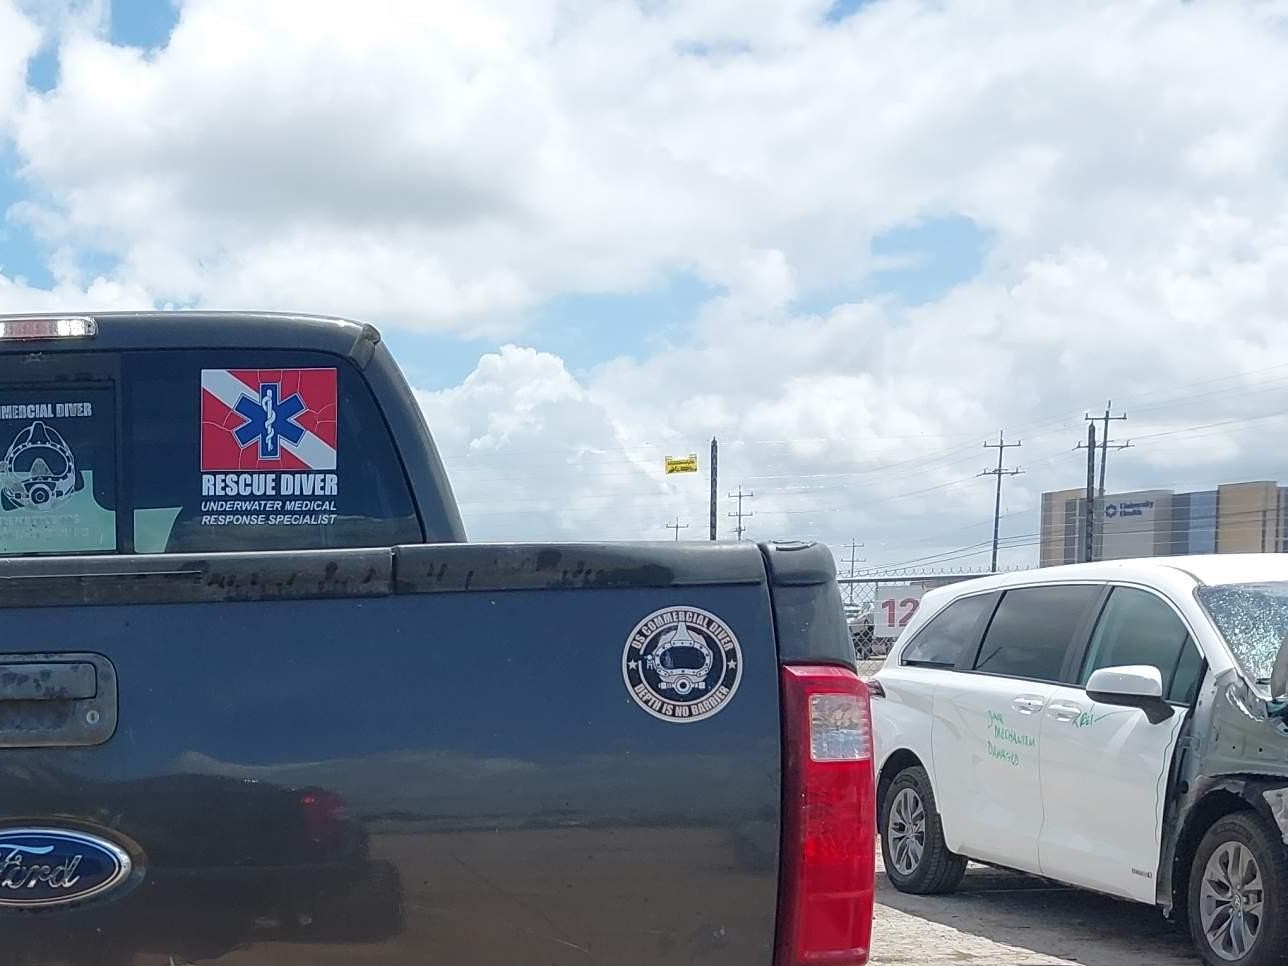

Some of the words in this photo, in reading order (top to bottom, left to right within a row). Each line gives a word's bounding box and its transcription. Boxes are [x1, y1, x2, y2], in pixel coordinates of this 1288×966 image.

[56, 402, 92, 417] DIVER
[202, 474, 276, 496] RESCUE
[281, 474, 338, 495] DIVER
[201, 501, 282, 511] UNDERWATER
[284, 501, 337, 510] MEDICAL
[201, 514, 265, 525] RESPONSE
[268, 514, 337, 524] SPECIALIST
[882, 598, 919, 627] 12
[631, 634, 644, 650] US
[641, 611, 709, 635] COMMERCIAL
[709, 621, 734, 651] DIVER
[634, 683, 660, 709] DEPTH
[661, 703, 673, 716] IS
[675, 705, 689, 717] NO
[691, 686, 730, 716] BARRIER
